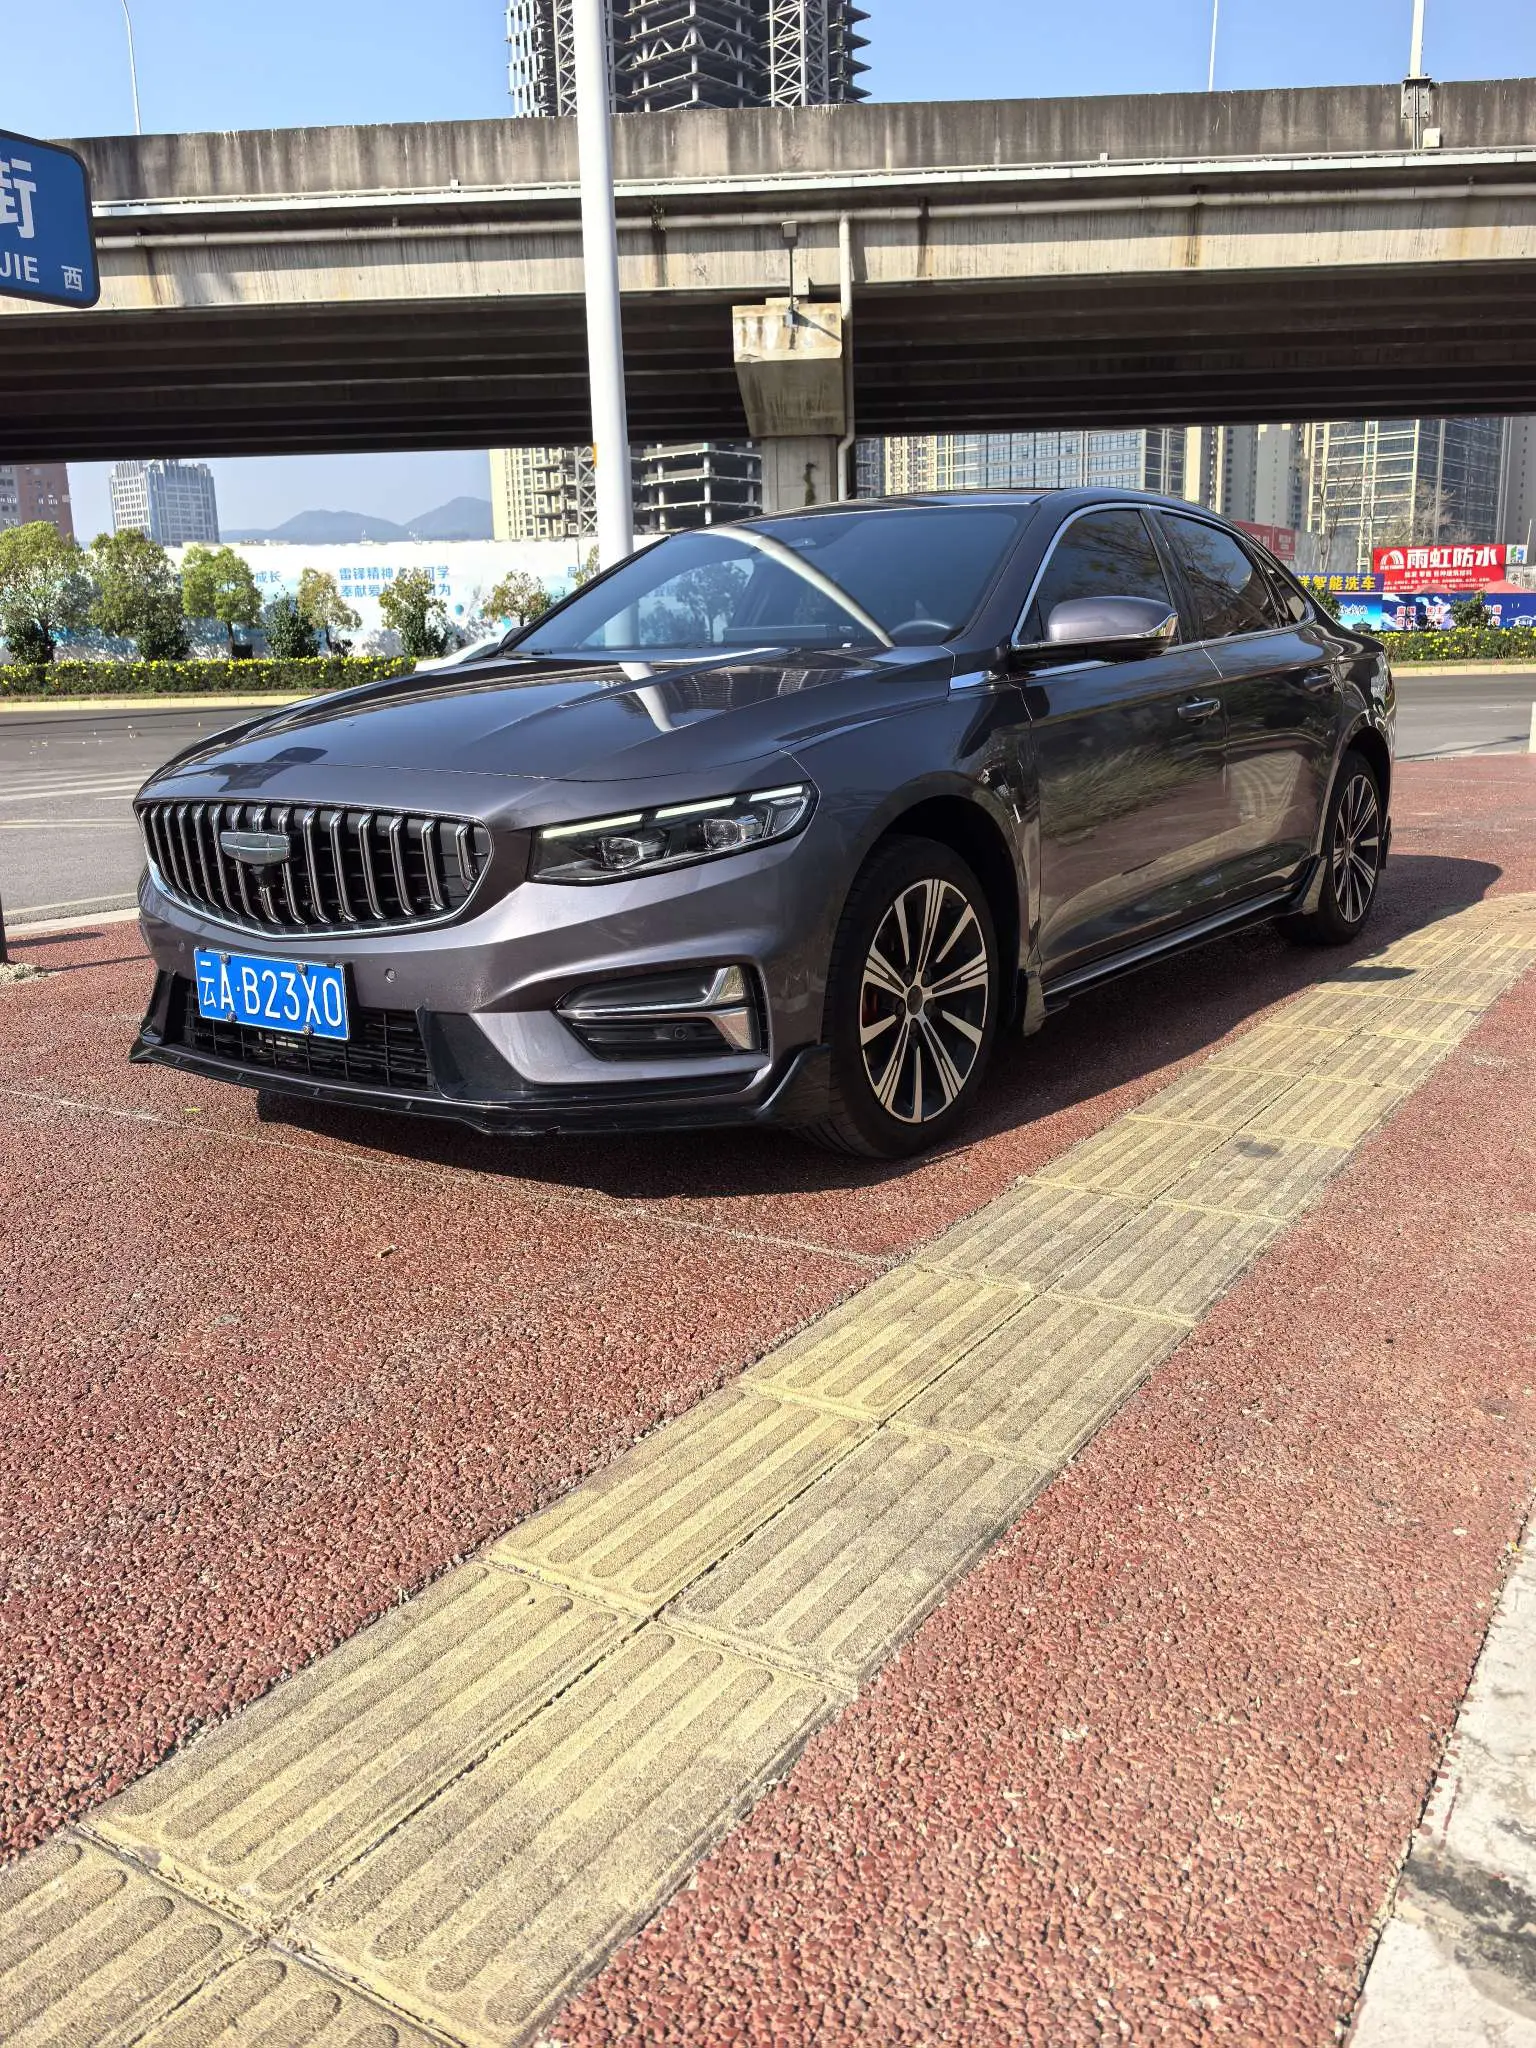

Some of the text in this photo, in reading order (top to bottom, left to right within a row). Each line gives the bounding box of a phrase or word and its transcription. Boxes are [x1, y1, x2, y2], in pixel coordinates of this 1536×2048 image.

[61, 265, 83, 292] 西
[1406, 546, 1497, 569] 雨虹防水
[255, 570, 282, 584] 成长
[338, 566, 393, 581] 雷锋精神
